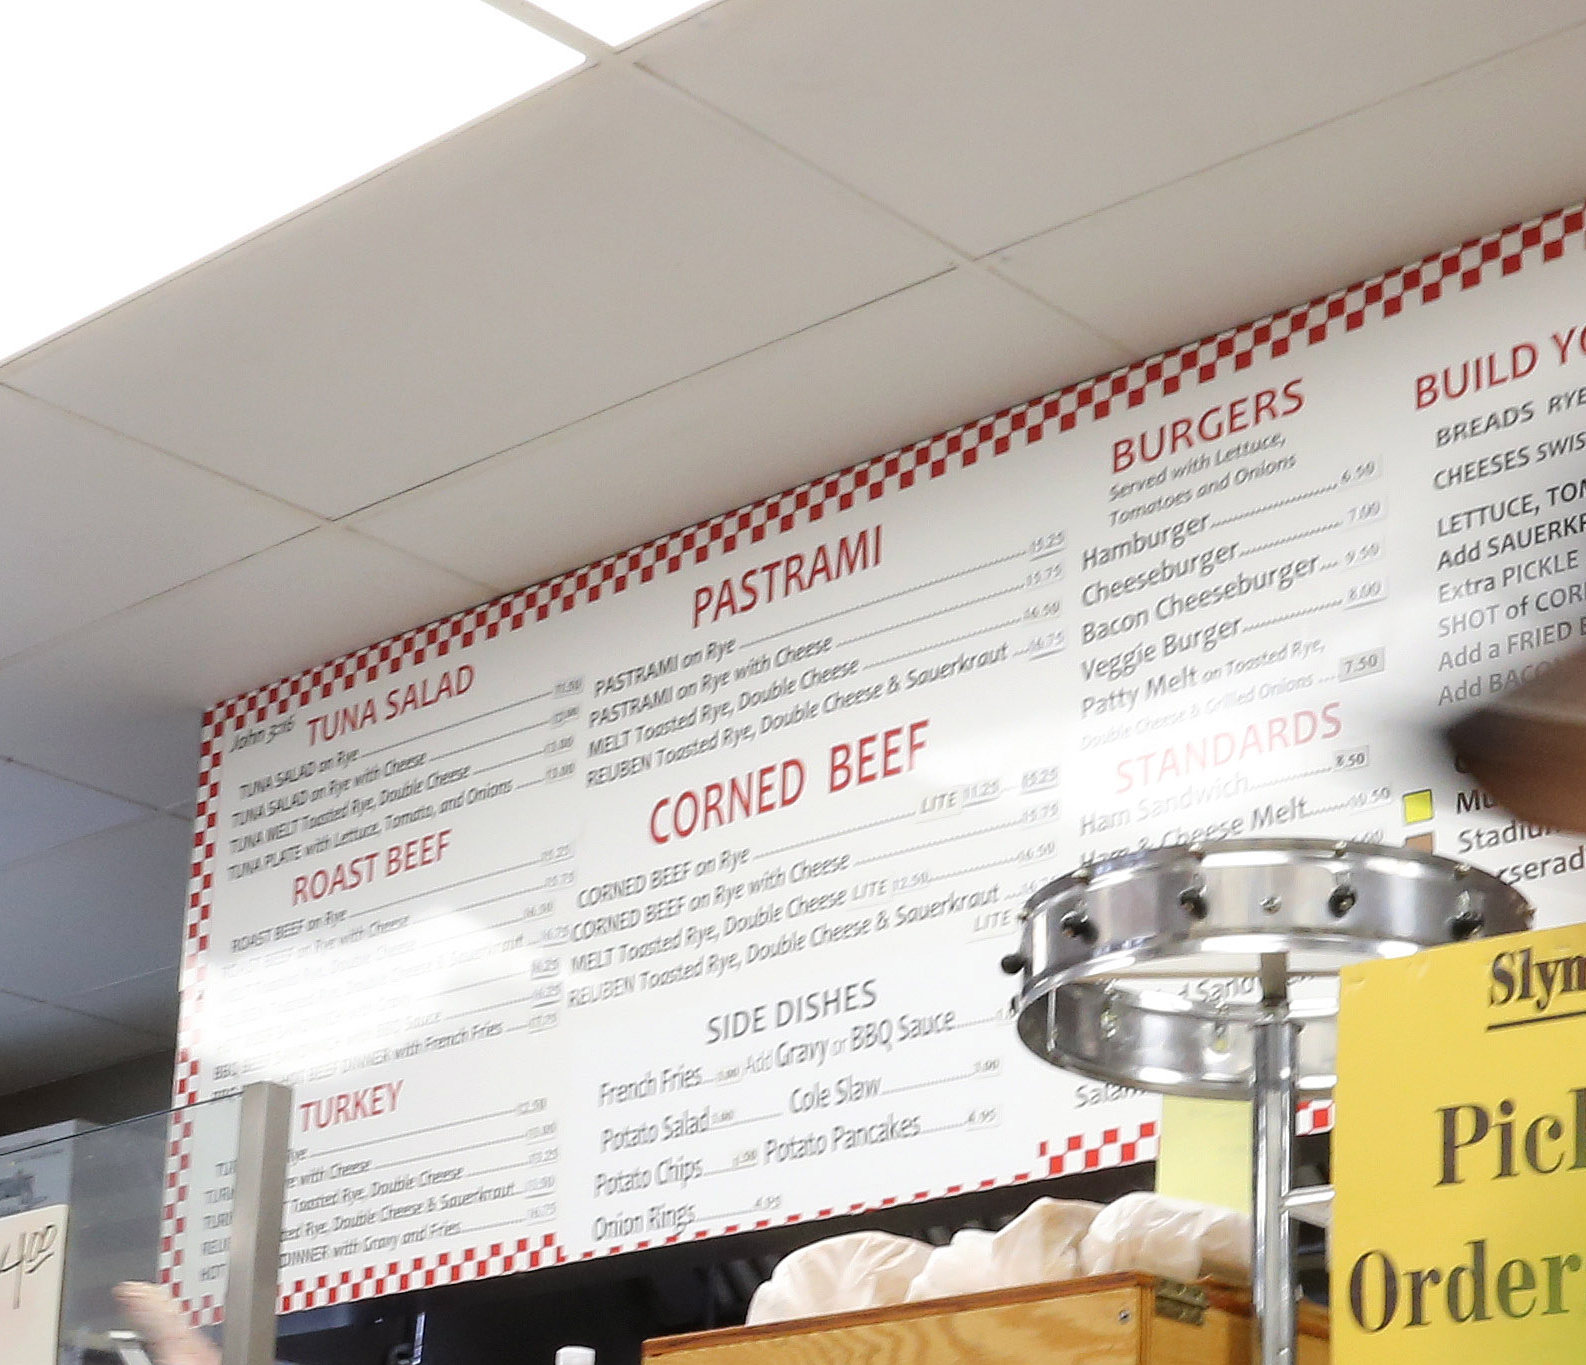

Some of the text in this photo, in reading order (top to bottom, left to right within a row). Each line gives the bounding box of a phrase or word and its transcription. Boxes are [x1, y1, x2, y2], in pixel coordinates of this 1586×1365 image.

[1415, 341, 1538, 409] BUILD
[1112, 380, 1305, 473] BURGERS
[1436, 400, 1535, 446] BREADS
[1110, 434, 1286, 500] Served with Lettuce,
[1110, 456, 1296, 527] Tomatoes and Onions
[1433, 445, 1530, 489] CHEESES
[1082, 515, 1212, 569] Hamburger
[1438, 493, 1540, 536] LETTUCE,
[692, 527, 884, 627] PASTRAMI
[1082, 544, 1240, 606] Cheeseburger
[1437, 541, 1480, 569] Add
[1438, 551, 1578, 602] Extra PICKLE
[1082, 558, 1320, 644] Bacon Cheeseburger
[1438, 605, 1499, 636] SHOT
[1506, 597, 1529, 620] of
[594, 641, 737, 696] PASTRAMI on Rye
[1083, 619, 1242, 679] Veggie Burger
[1438, 620, 1571, 669] Add a FRIED
[308, 666, 475, 746] TUNA SALAD
[589, 641, 833, 727] PASTRAMI on Rye with Cheese
[589, 661, 860, 756] MELT Toasted Rye, Double Cheese
[1081, 665, 1198, 718] Patty Melt
[587, 644, 1007, 787] REUBEN Toasted Rye, Double Cheese & Sauerkraut
[1116, 706, 1342, 793] STANDARDS
[649, 724, 930, 845] CORNED BEEF
[293, 829, 453, 905] ROAST BEEF
[706, 982, 878, 1044] SIDE DISHES
[300, 1082, 404, 1132] TURKEY
[598, 1064, 702, 1108] French Fries
[790, 1077, 881, 1115] Cole Slaw
[602, 1107, 710, 1153] Potato Salad
[764, 1115, 920, 1165] Potato Pancakes
[595, 1155, 703, 1196] Potato Chips
[593, 1203, 695, 1241] Onion Rings
